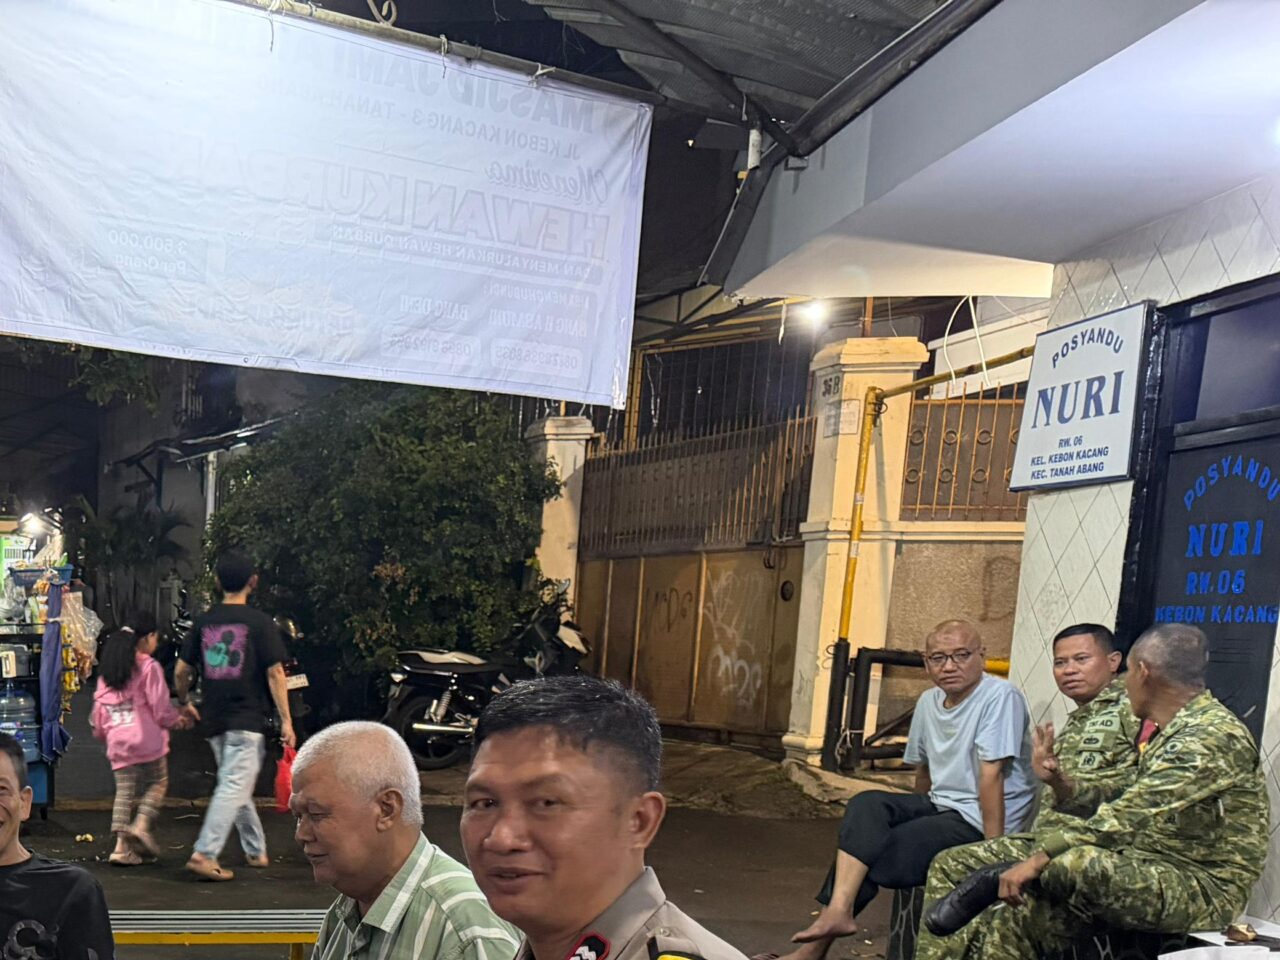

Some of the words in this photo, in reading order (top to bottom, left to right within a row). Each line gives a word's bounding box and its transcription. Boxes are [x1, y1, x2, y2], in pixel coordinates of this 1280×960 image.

[1052, 327, 1123, 368] POSYANDU
[1031, 371, 1125, 429] NURI
[1073, 436, 1083, 446] 06
[1031, 455, 1046, 467] KEL.
[1048, 451, 1073, 464] KEBON
[1075, 446, 1109, 460] KACANG
[1031, 469, 1047, 480] KEC.
[1049, 465, 1074, 477] TANAH
[1076, 461, 1104, 474] ABANG
[1184, 455, 1280, 511] POSYANDU
[1185, 520, 1264, 558] NURI
[1219, 570, 1245, 594] 06
[1155, 606, 1204, 623] KEBON
[1210, 606, 1279, 624] KACANG
